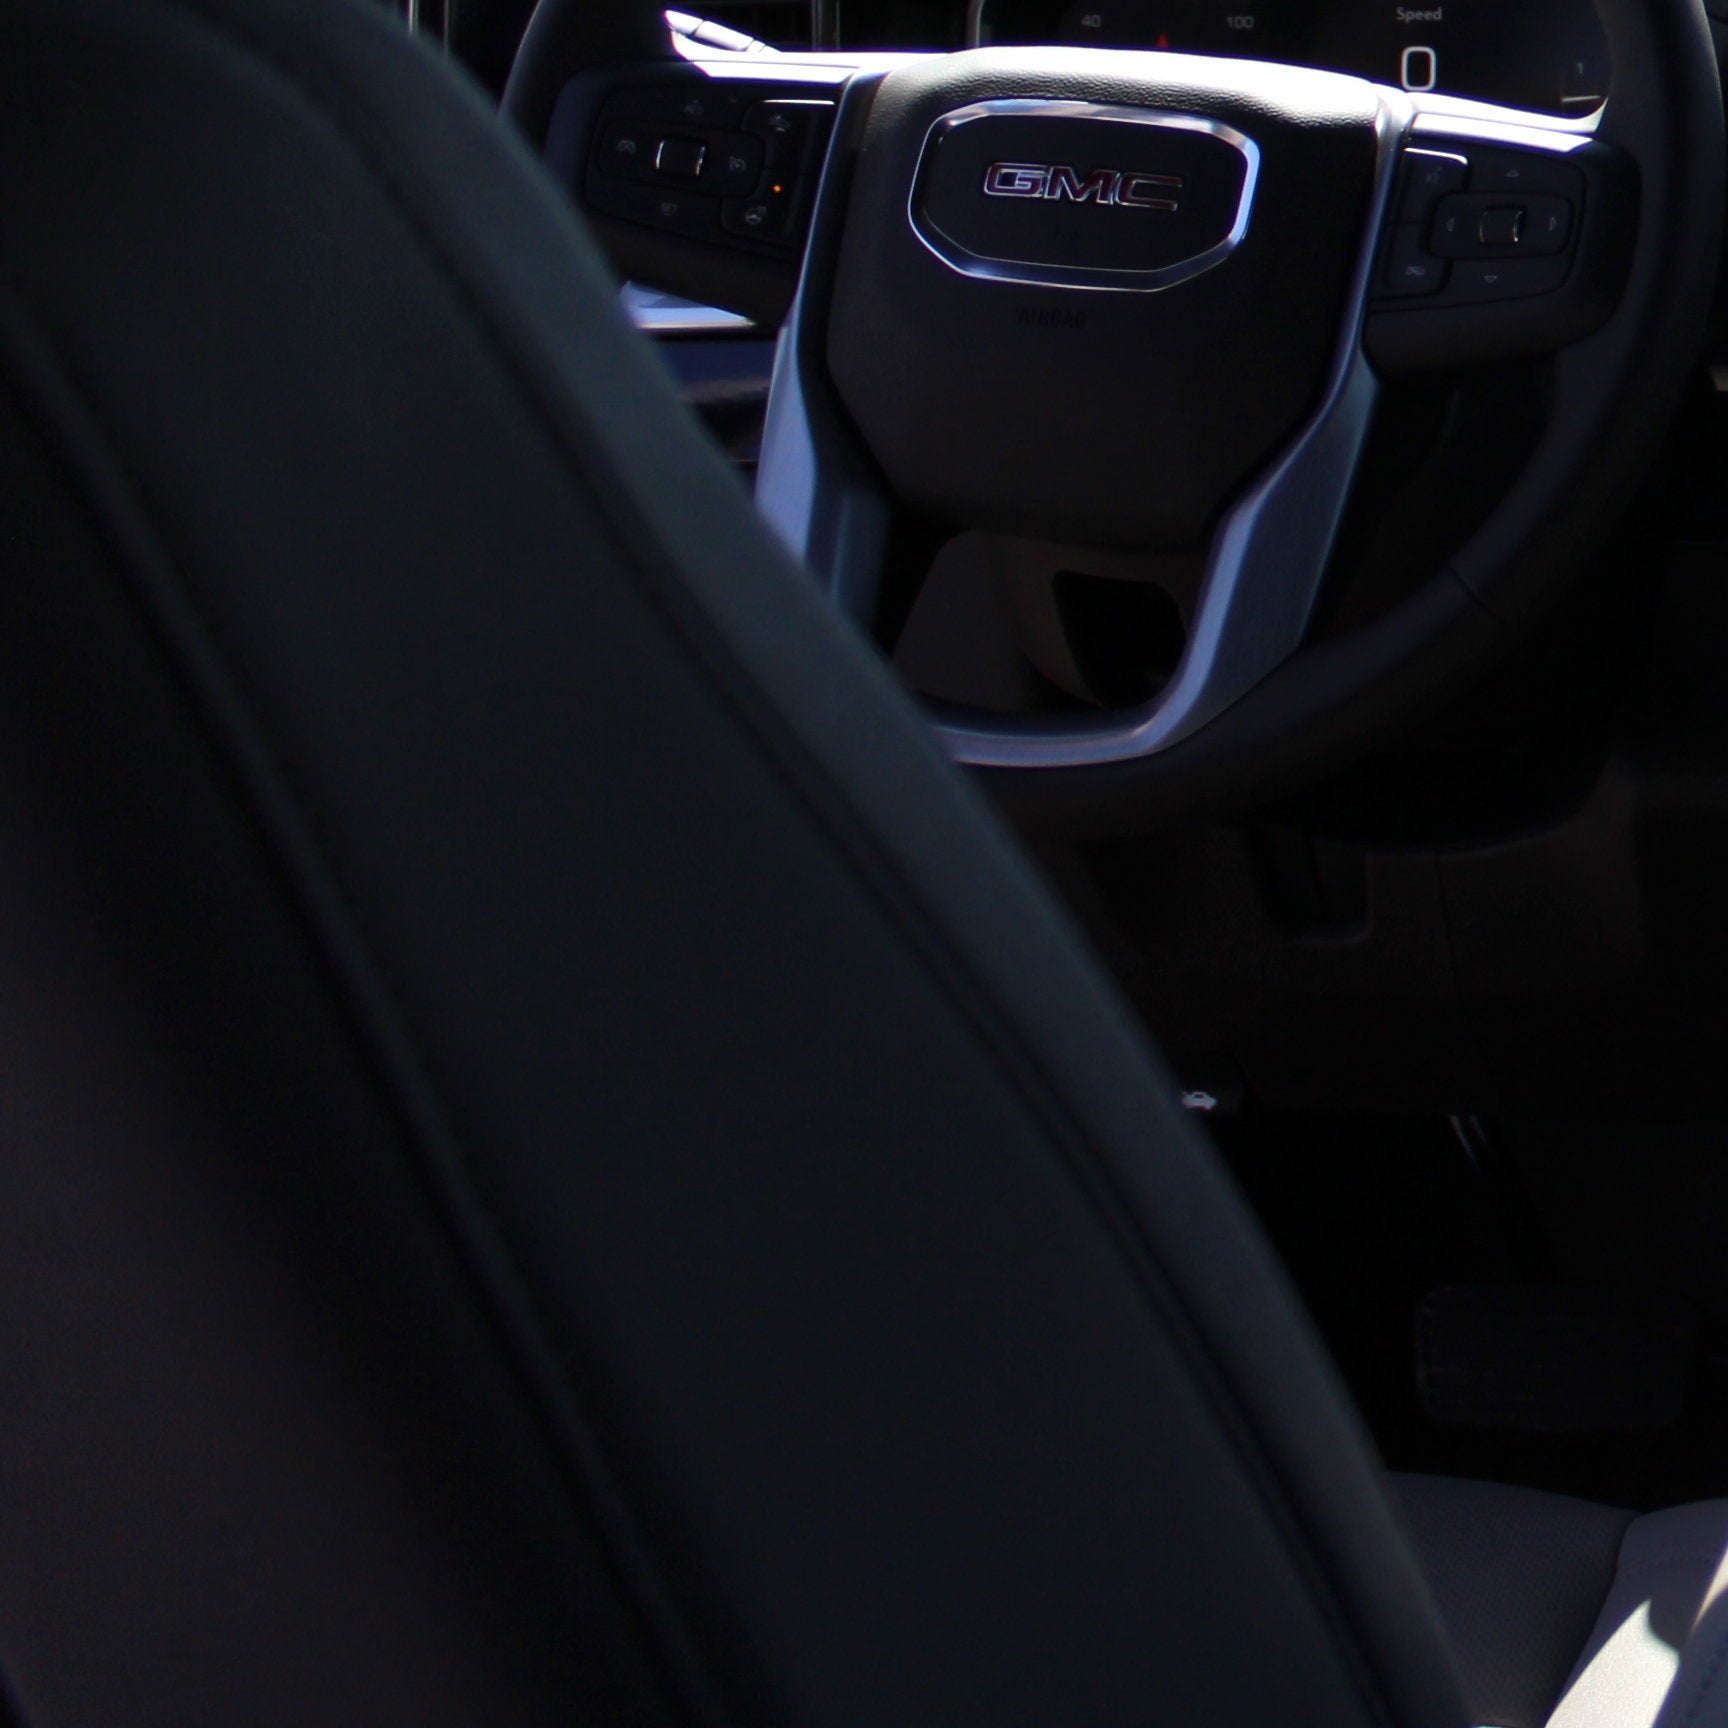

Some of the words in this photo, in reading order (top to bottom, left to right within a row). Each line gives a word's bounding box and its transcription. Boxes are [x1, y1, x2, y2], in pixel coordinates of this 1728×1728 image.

[1081, 14, 1102, 28] 40
[1226, 15, 1254, 29] 100
[1395, 6, 1443, 24] Speed
[1400, 45, 1437, 92] 0
[984, 162, 1183, 211] GMC
[1017, 307, 1088, 330] AIRBAG
